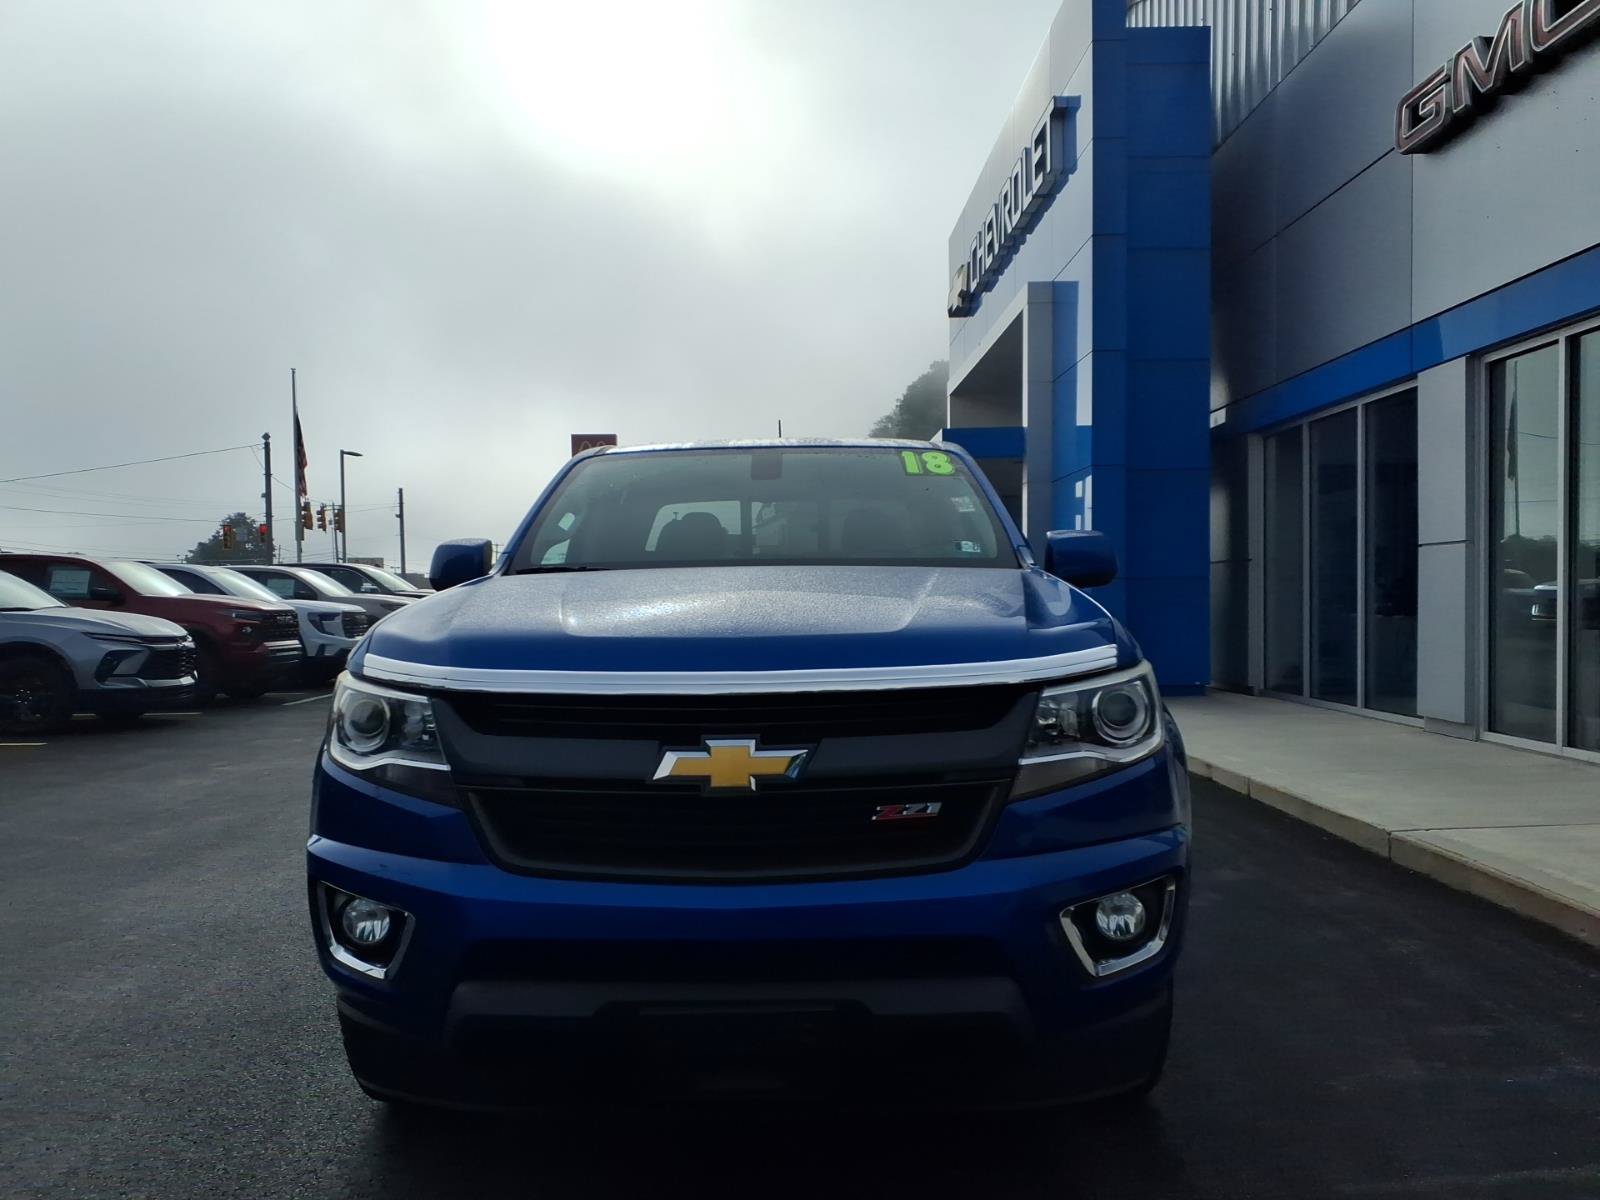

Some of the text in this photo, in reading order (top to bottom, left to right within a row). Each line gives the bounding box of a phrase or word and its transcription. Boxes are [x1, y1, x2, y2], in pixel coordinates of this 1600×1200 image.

[969, 95, 1071, 294] CHEVROLET
[901, 450, 956, 476] 18
[871, 801, 943, 822] Z71
